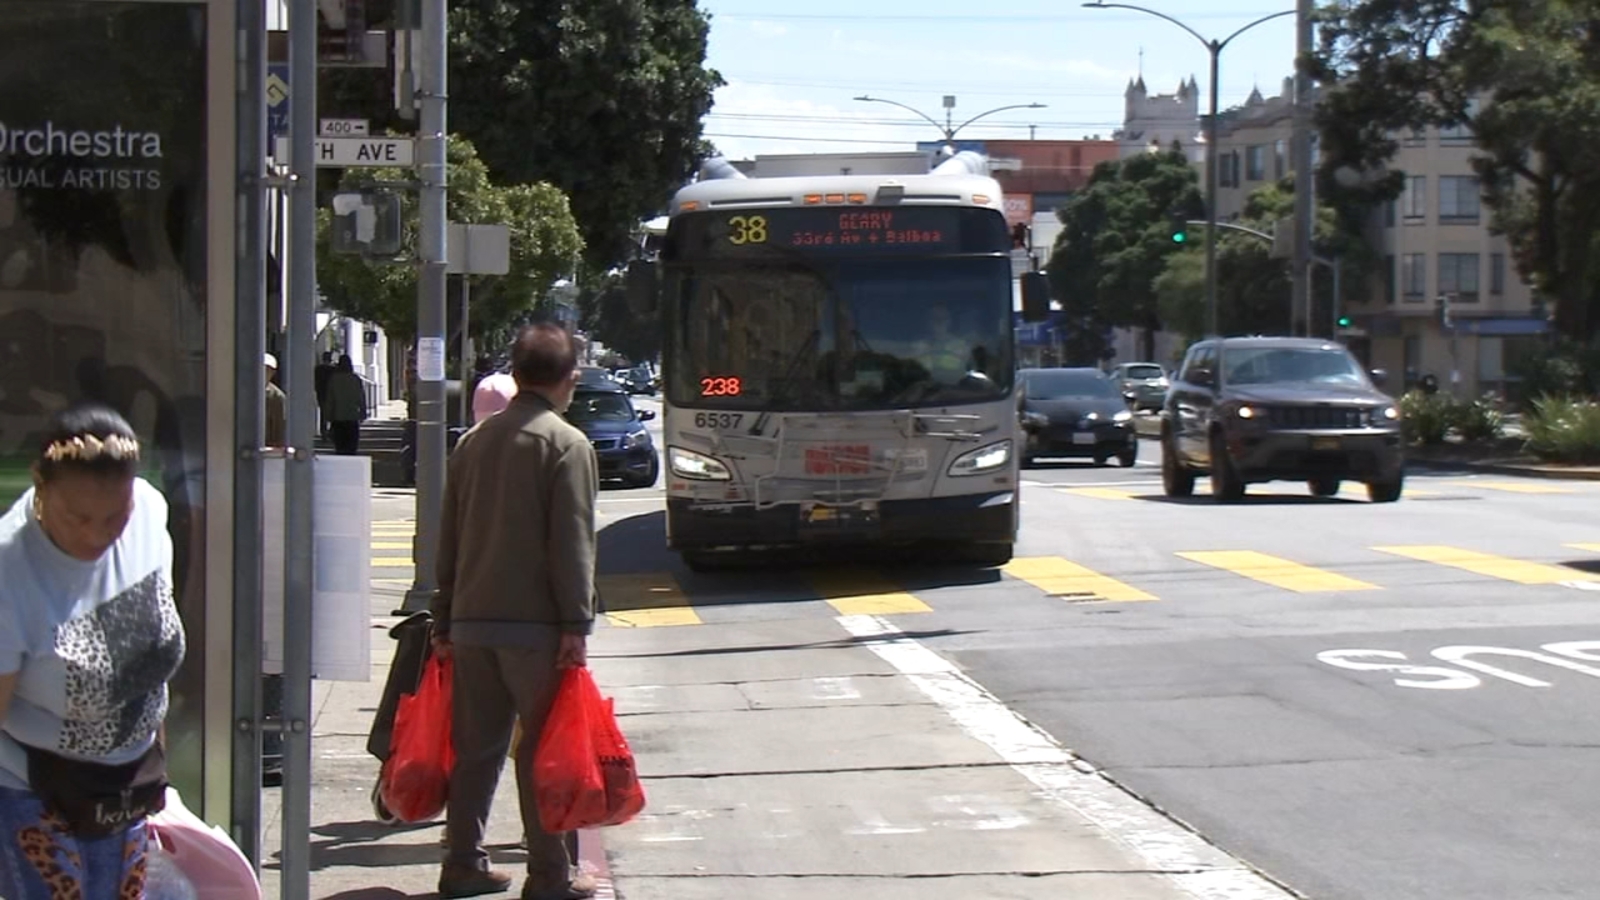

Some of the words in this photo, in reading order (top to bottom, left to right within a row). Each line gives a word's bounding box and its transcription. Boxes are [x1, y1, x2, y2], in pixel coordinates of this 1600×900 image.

[325, 121, 352, 133] 400
[315, 143, 335, 161] H
[356, 143, 398, 161] AVE
[61, 169, 161, 190] ARTISTS
[729, 214, 768, 246] 38
[838, 213, 893, 230] GEARY
[700, 377, 741, 396] 238
[694, 411, 744, 430] 6537
